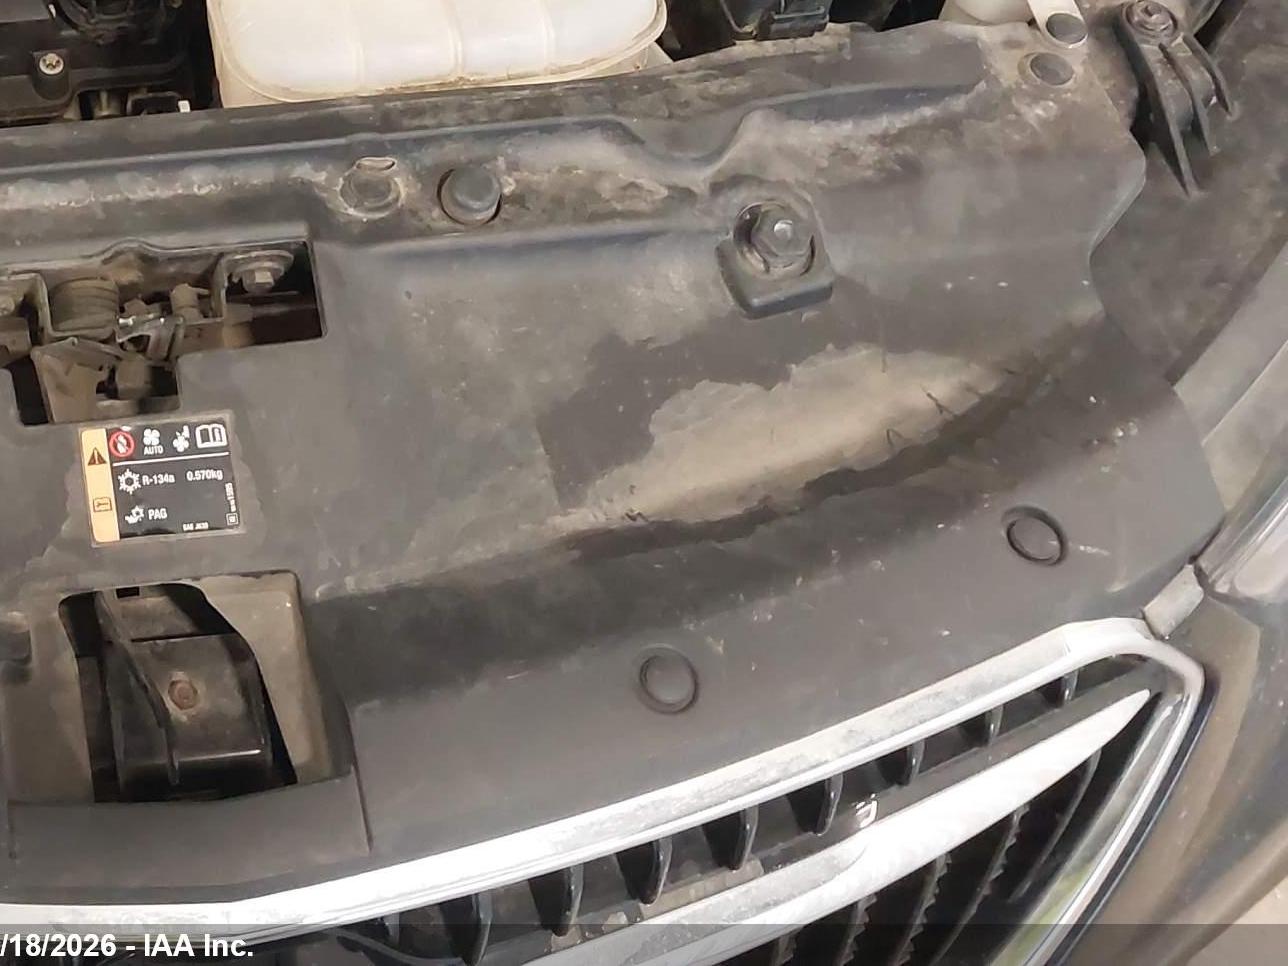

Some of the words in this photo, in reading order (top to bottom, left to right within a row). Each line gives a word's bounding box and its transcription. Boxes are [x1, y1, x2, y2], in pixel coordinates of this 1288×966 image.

[143, 445, 164, 455] AUTO
[142, 472, 175, 485] R-134a
[186, 469, 223, 481] 0.570kg
[148, 507, 168, 520] PAG
